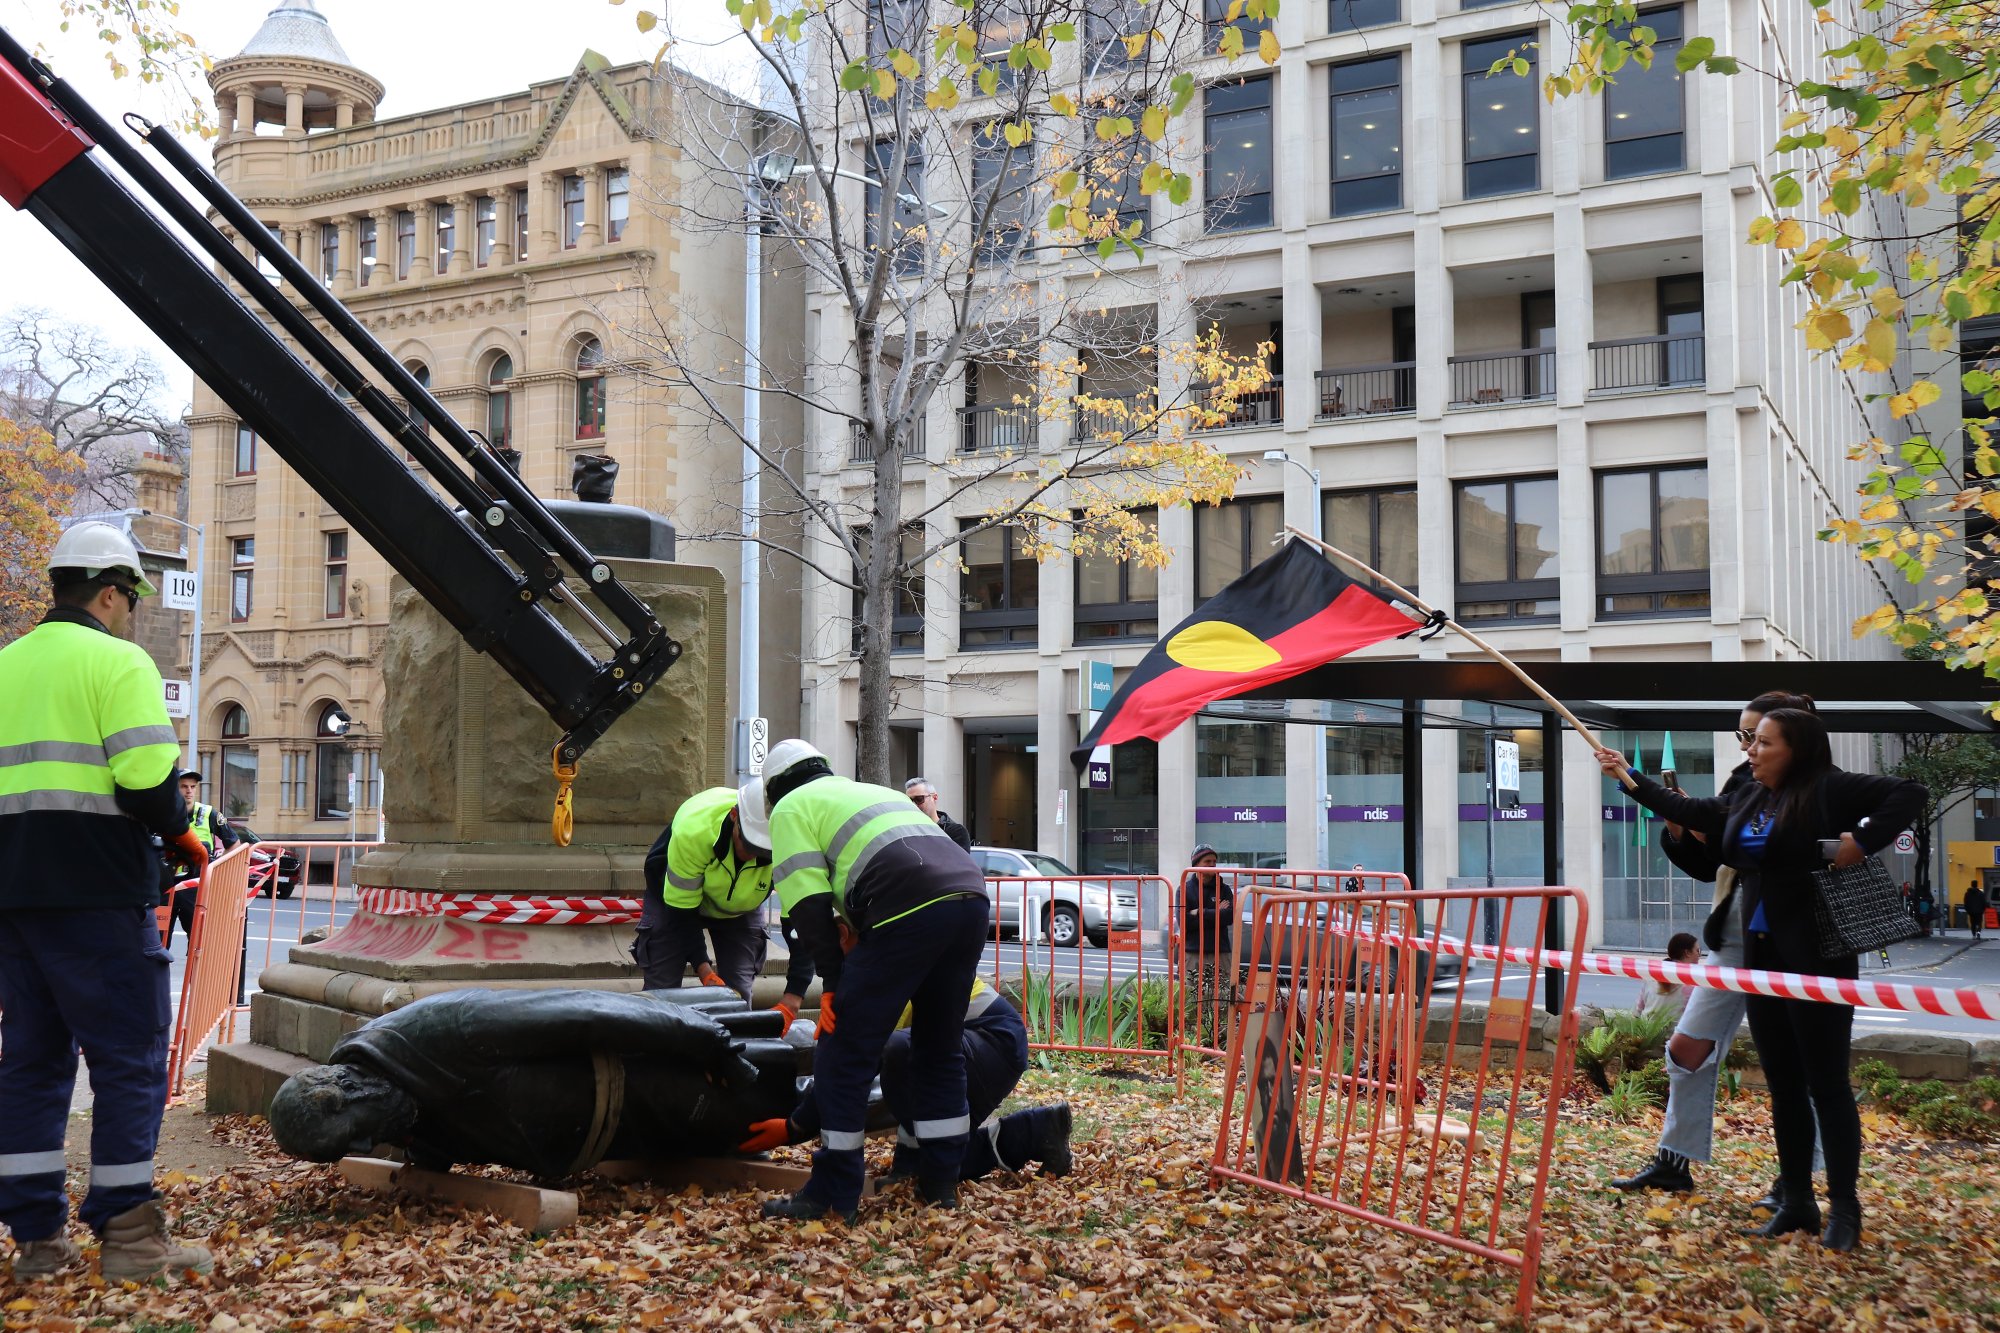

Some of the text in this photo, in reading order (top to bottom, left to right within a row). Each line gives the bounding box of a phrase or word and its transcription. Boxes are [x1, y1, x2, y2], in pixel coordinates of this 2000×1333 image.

[172, 577, 195, 597] 119
[1093, 681, 1111, 691] shadforth
[1498, 746, 1508, 759] Car
[1092, 767, 1107, 782] ndis
[1234, 808, 1258, 821] ndis
[1363, 807, 1389, 820] ndis
[1604, 807, 1613, 819] ndis
[1113, 833, 1128, 841] ndis
[1898, 838, 1911, 847] 40
